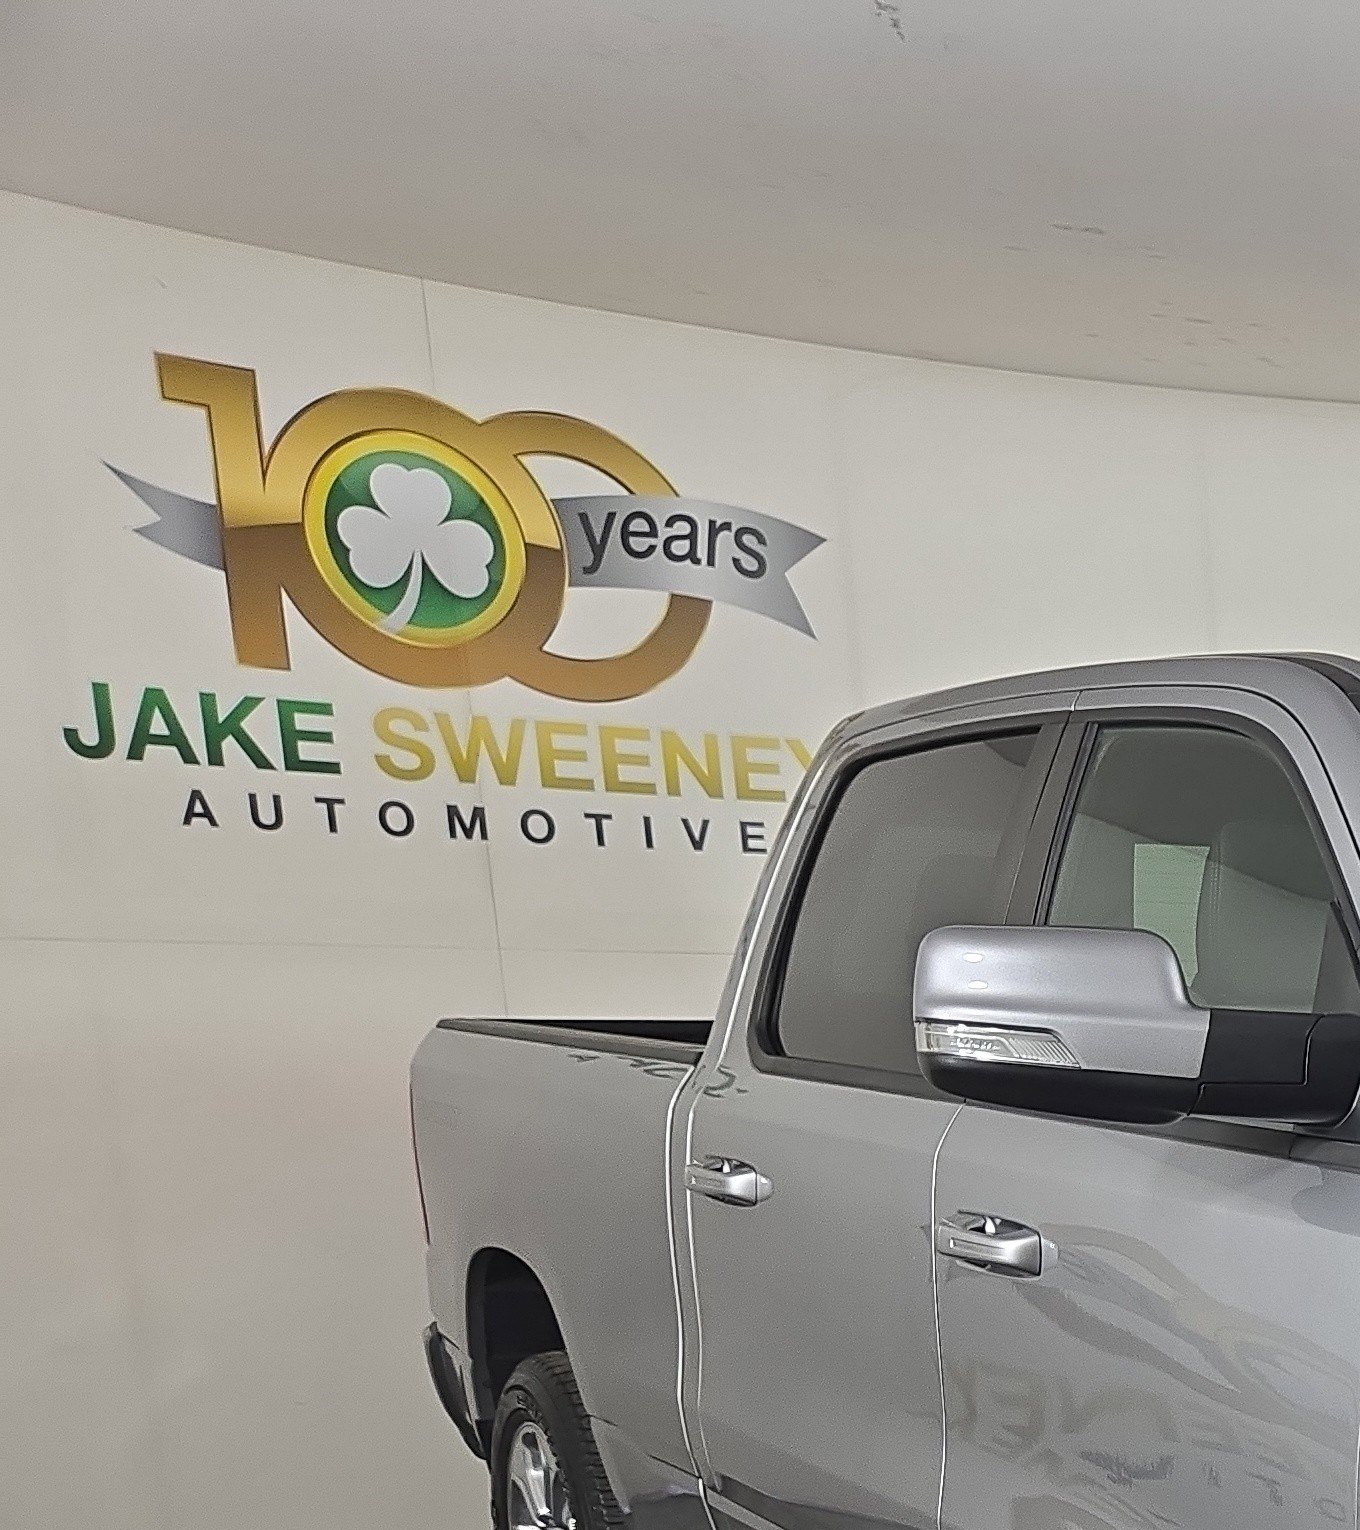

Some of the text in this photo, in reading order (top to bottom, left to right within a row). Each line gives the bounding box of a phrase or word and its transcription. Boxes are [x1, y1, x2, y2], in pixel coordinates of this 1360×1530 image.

[153, 351, 768, 704] 100 years
[63, 681, 343, 776] JAKE
[183, 789, 769, 855] AUTOMOTIVE
